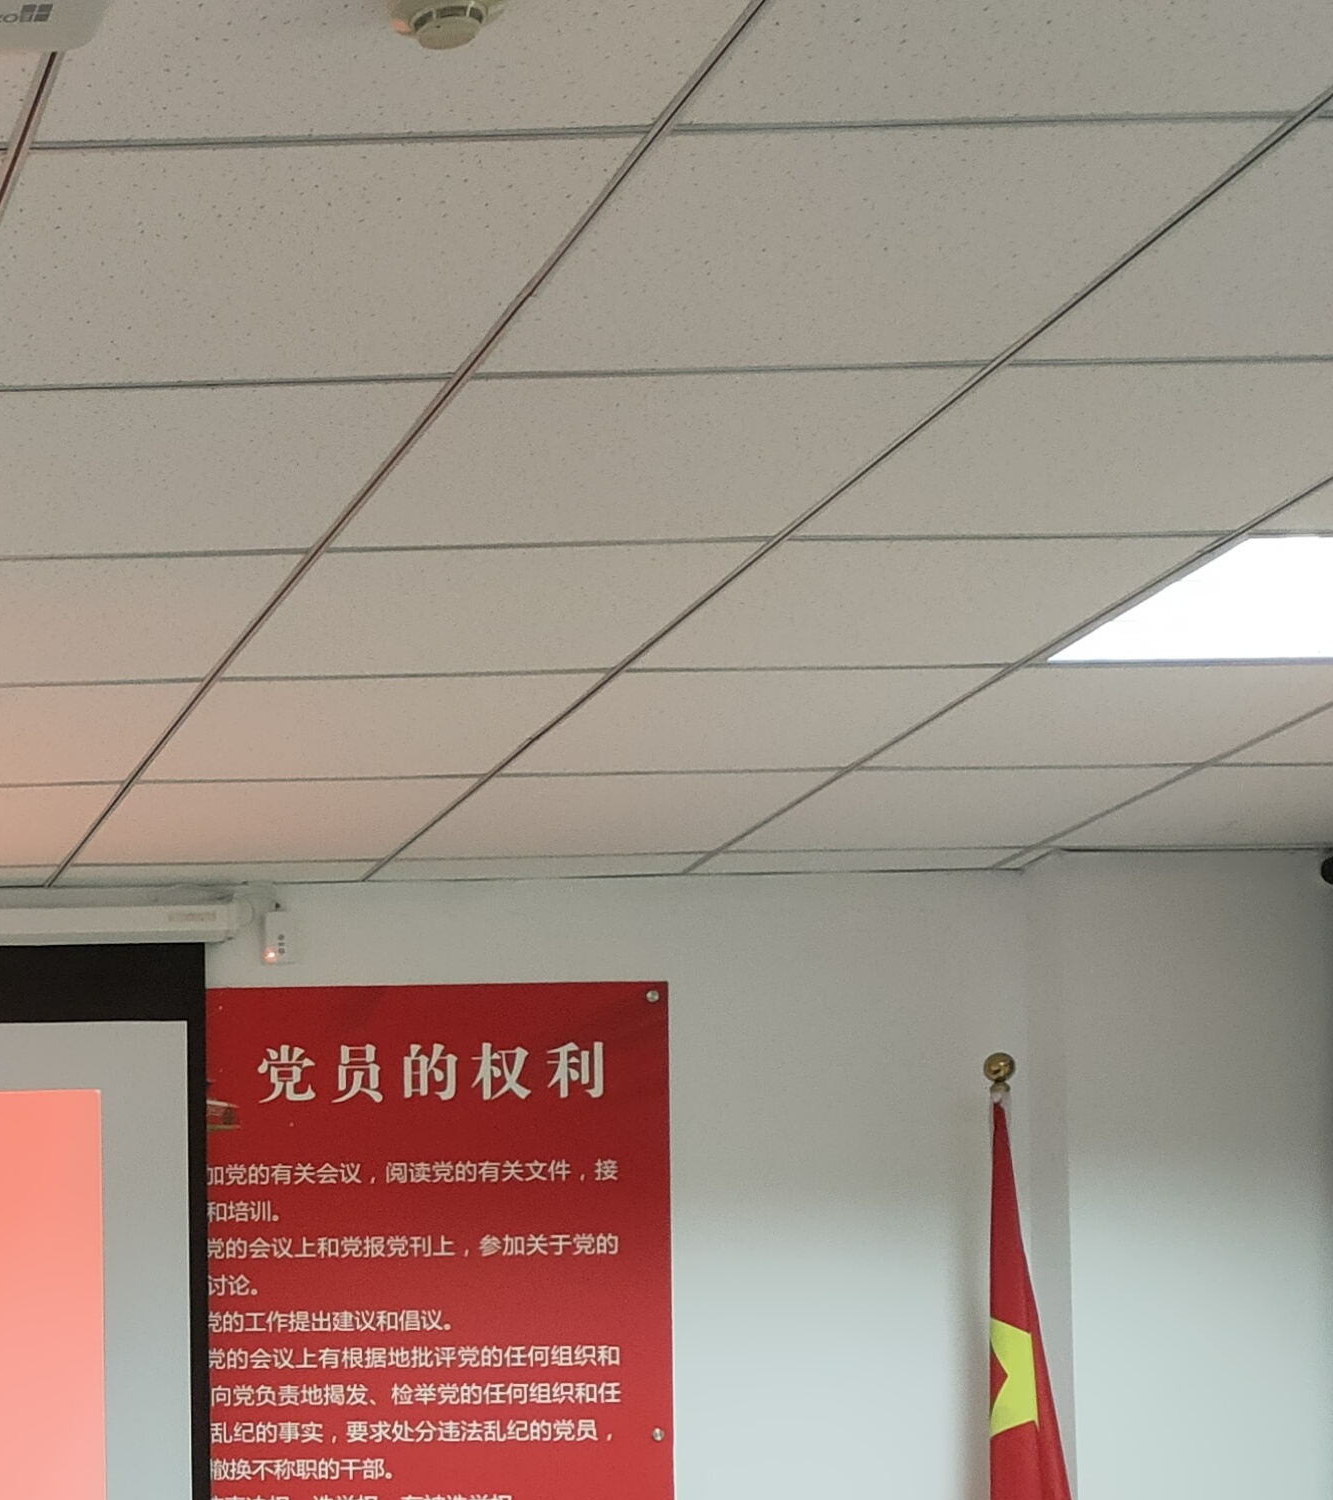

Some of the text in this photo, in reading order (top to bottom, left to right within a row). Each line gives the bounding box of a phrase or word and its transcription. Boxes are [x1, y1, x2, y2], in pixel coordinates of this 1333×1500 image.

[258, 1042, 603, 1102] 党员的权利
[208, 1201, 278, 1222] 和培训。
